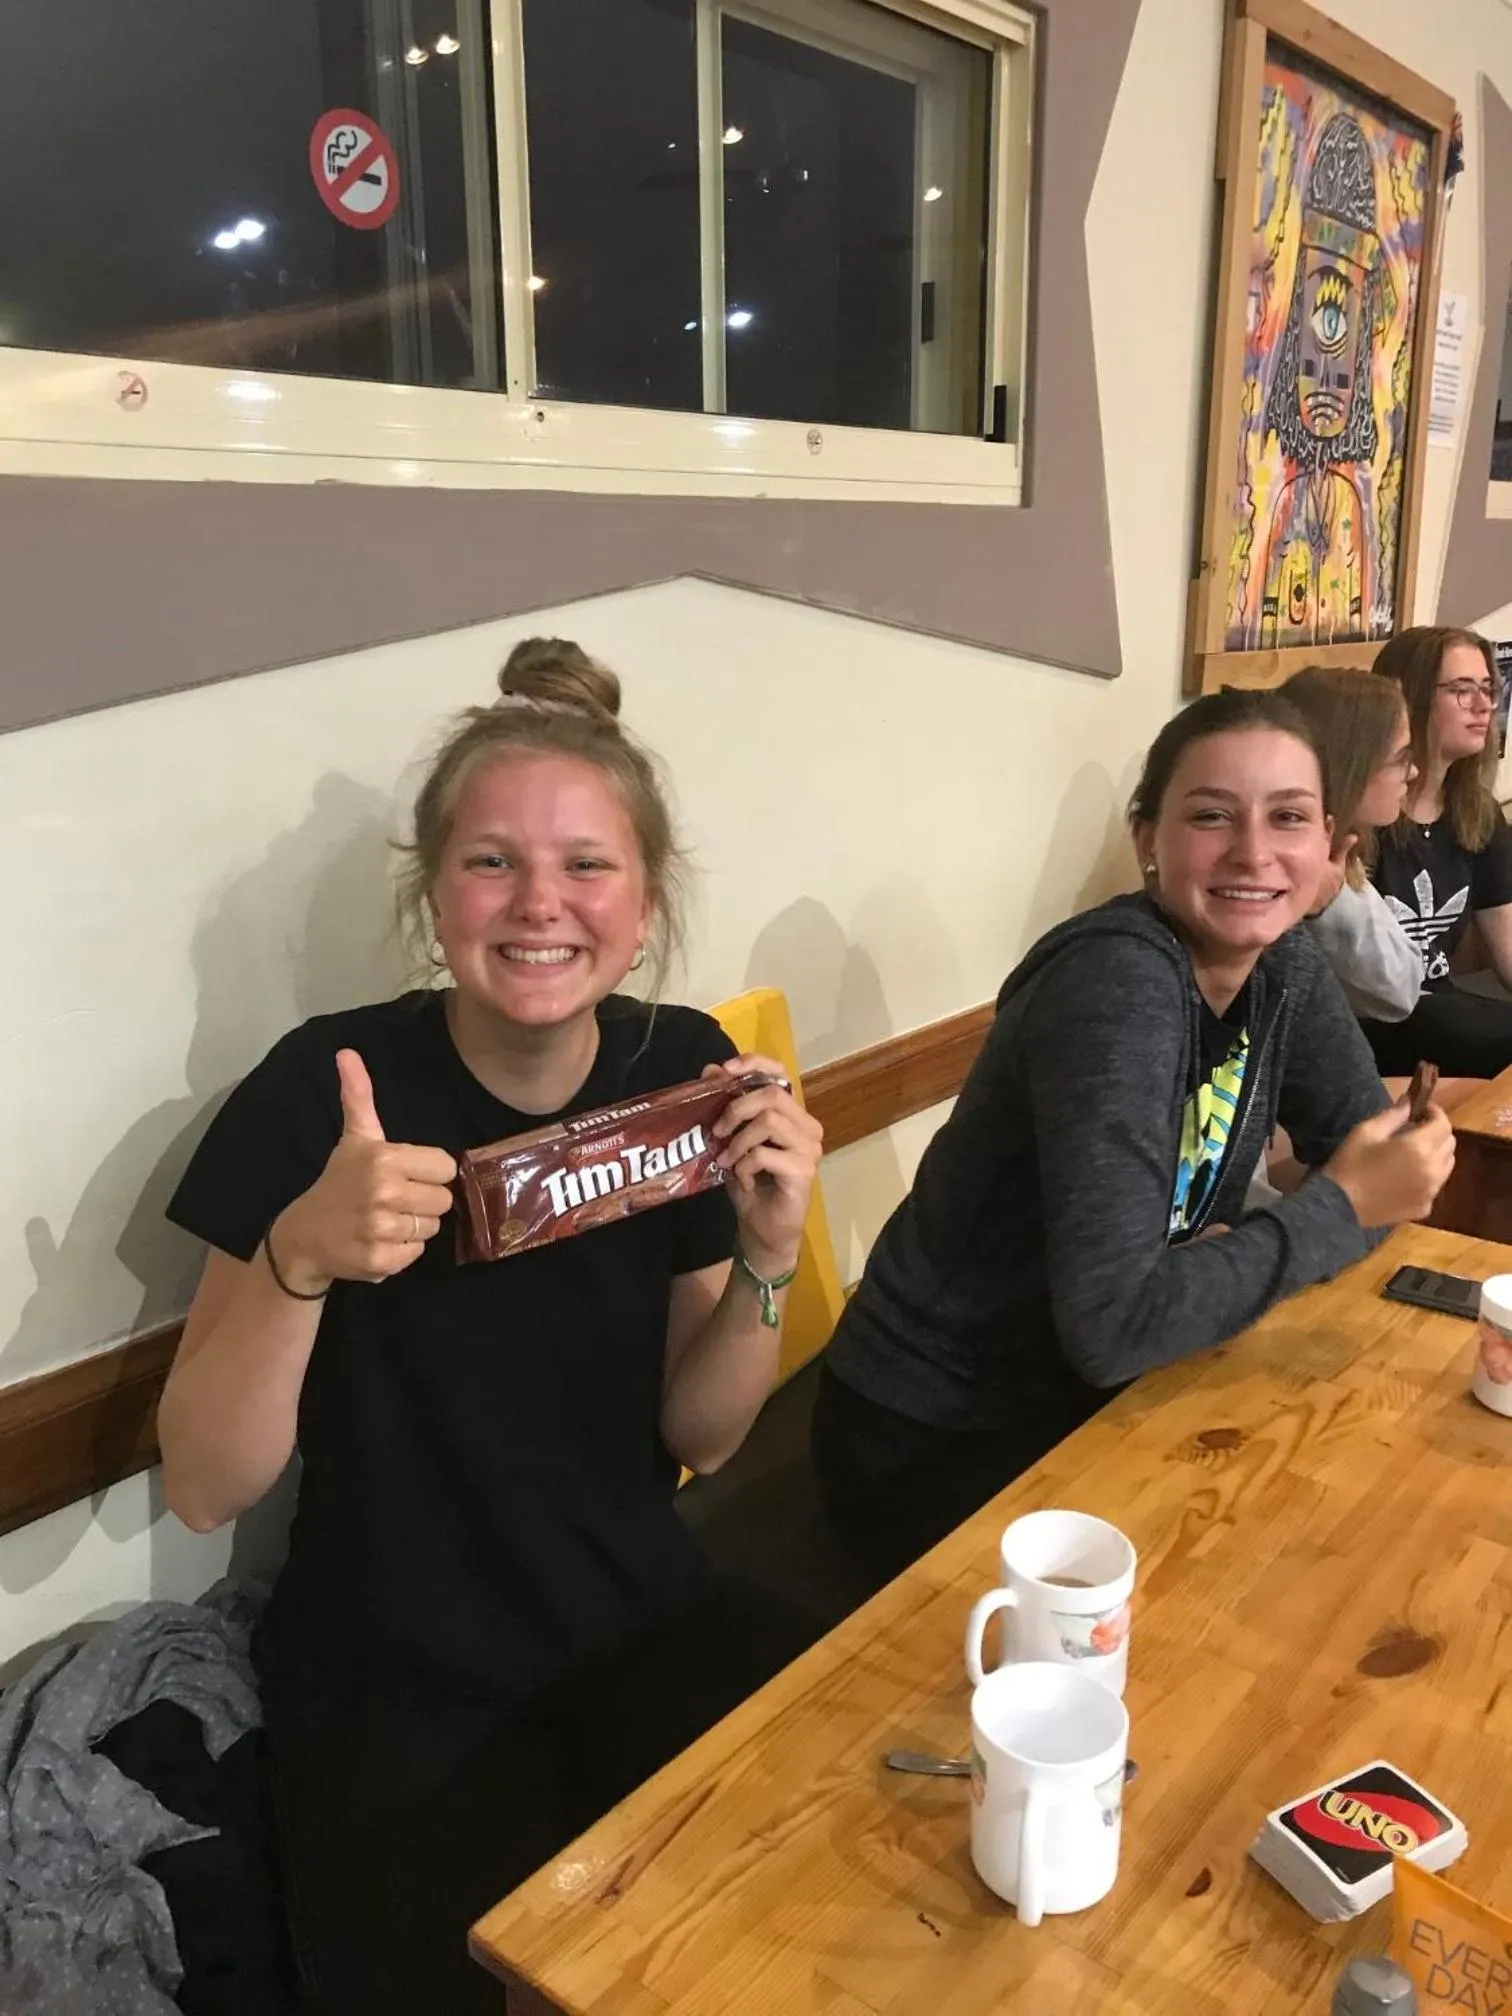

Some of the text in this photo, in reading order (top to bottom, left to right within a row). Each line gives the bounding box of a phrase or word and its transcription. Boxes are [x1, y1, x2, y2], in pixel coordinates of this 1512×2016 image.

[1318, 1790, 1419, 1854] UNO
[1410, 1918, 1512, 2000] EVER
[1425, 1963, 1504, 2016] DAY
